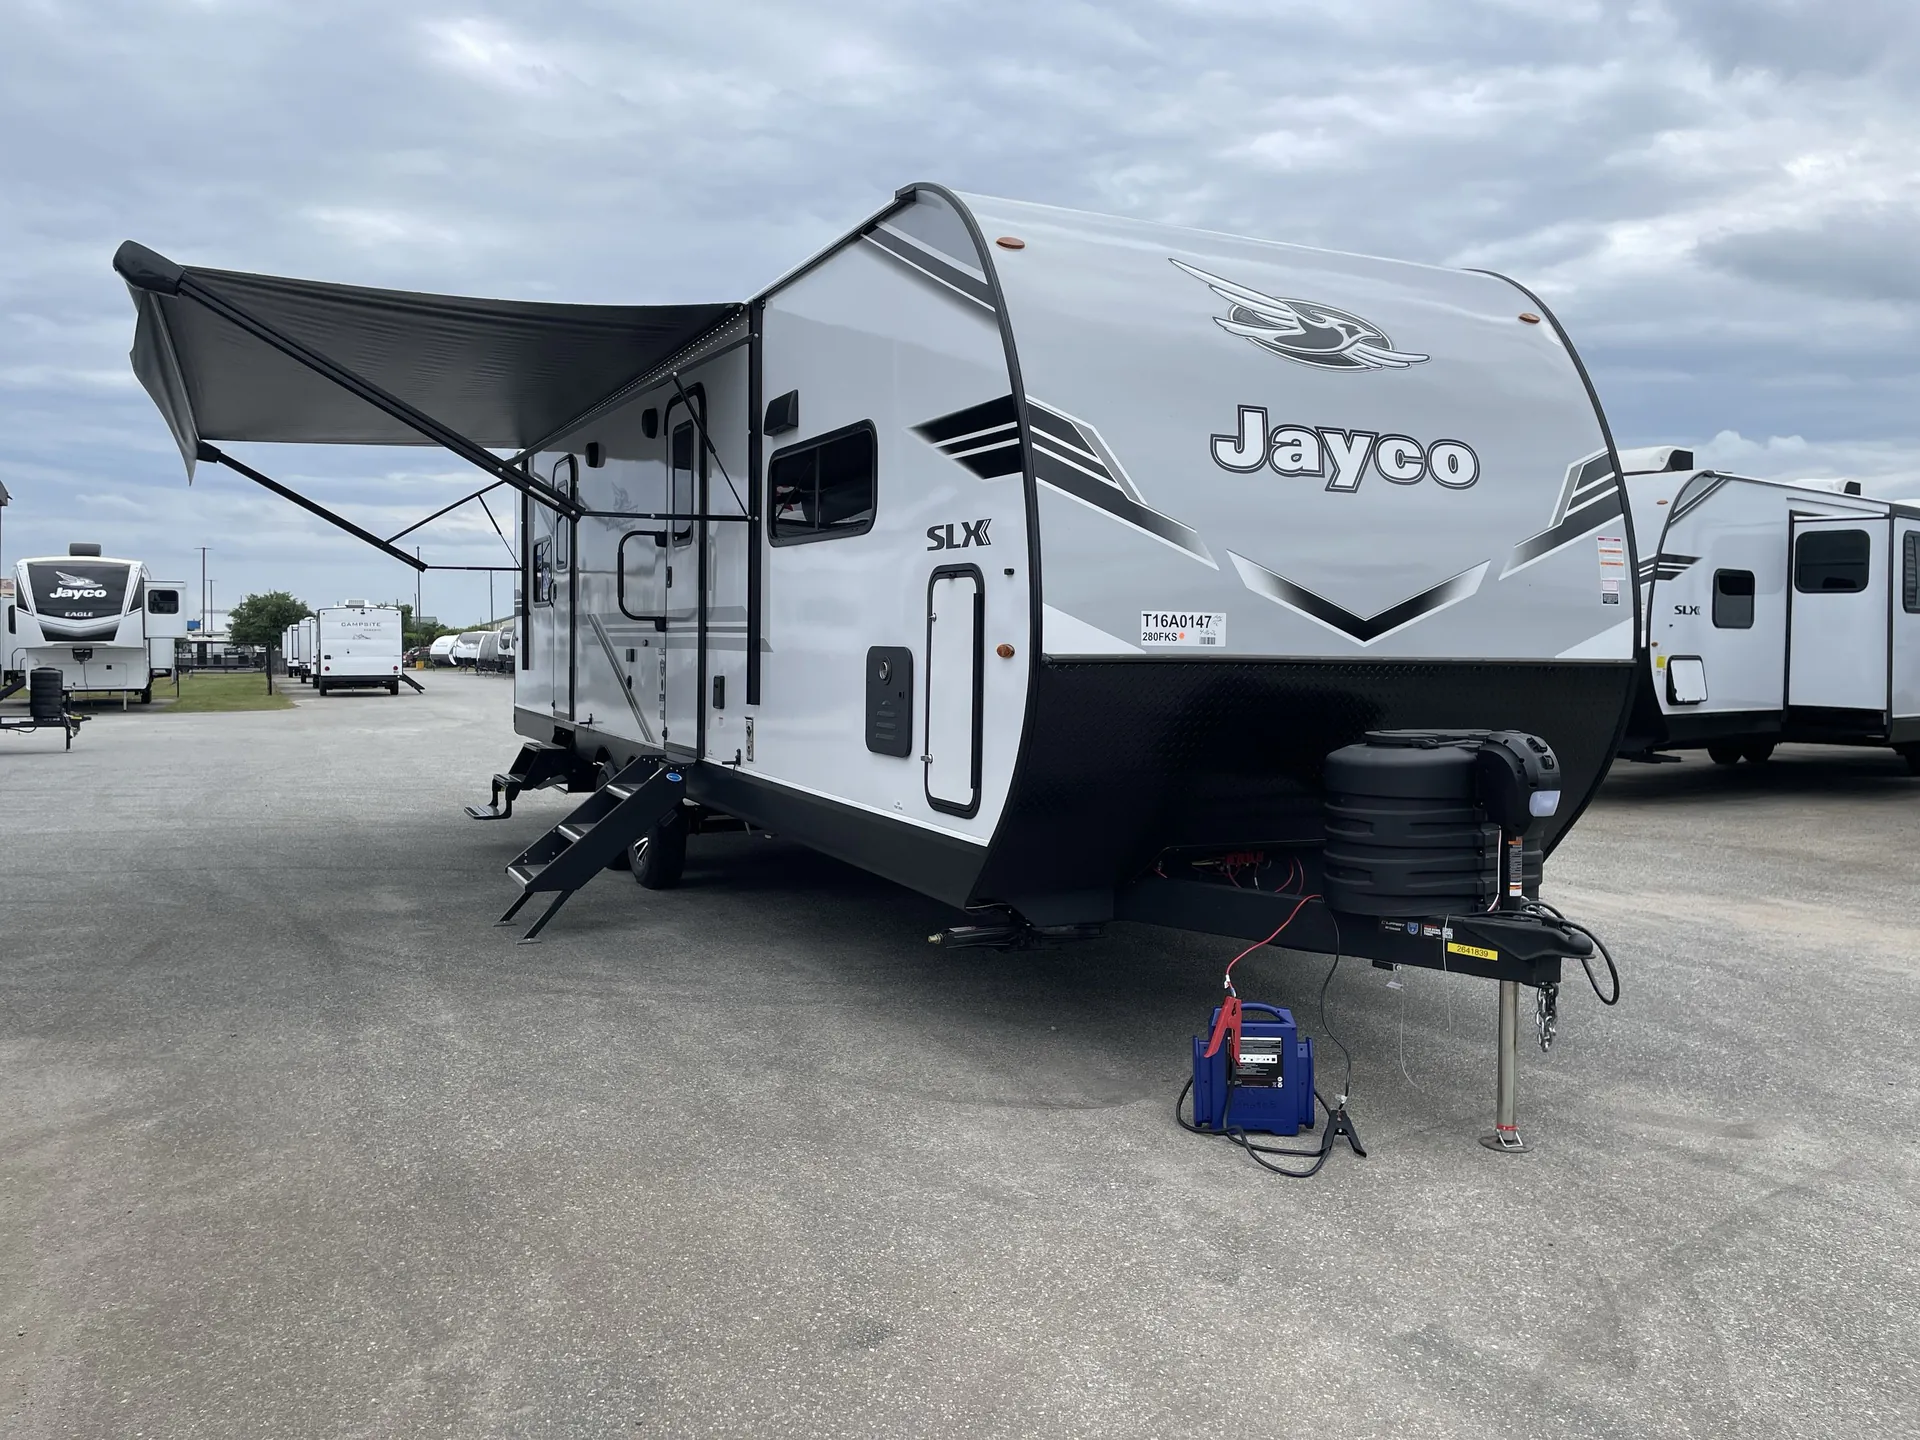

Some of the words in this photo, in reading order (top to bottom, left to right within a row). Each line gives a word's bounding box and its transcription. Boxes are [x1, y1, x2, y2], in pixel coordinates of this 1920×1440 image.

[1210, 404, 1480, 493] Jayco
[926, 518, 992, 551] SLX
[49, 587, 107, 600] Jayco
[1674, 605, 1700, 615] SLX
[1142, 613, 1212, 629] T16A0147
[1142, 632, 1178, 642] 280FKS
[1456, 945, 1489, 957] 2641839
